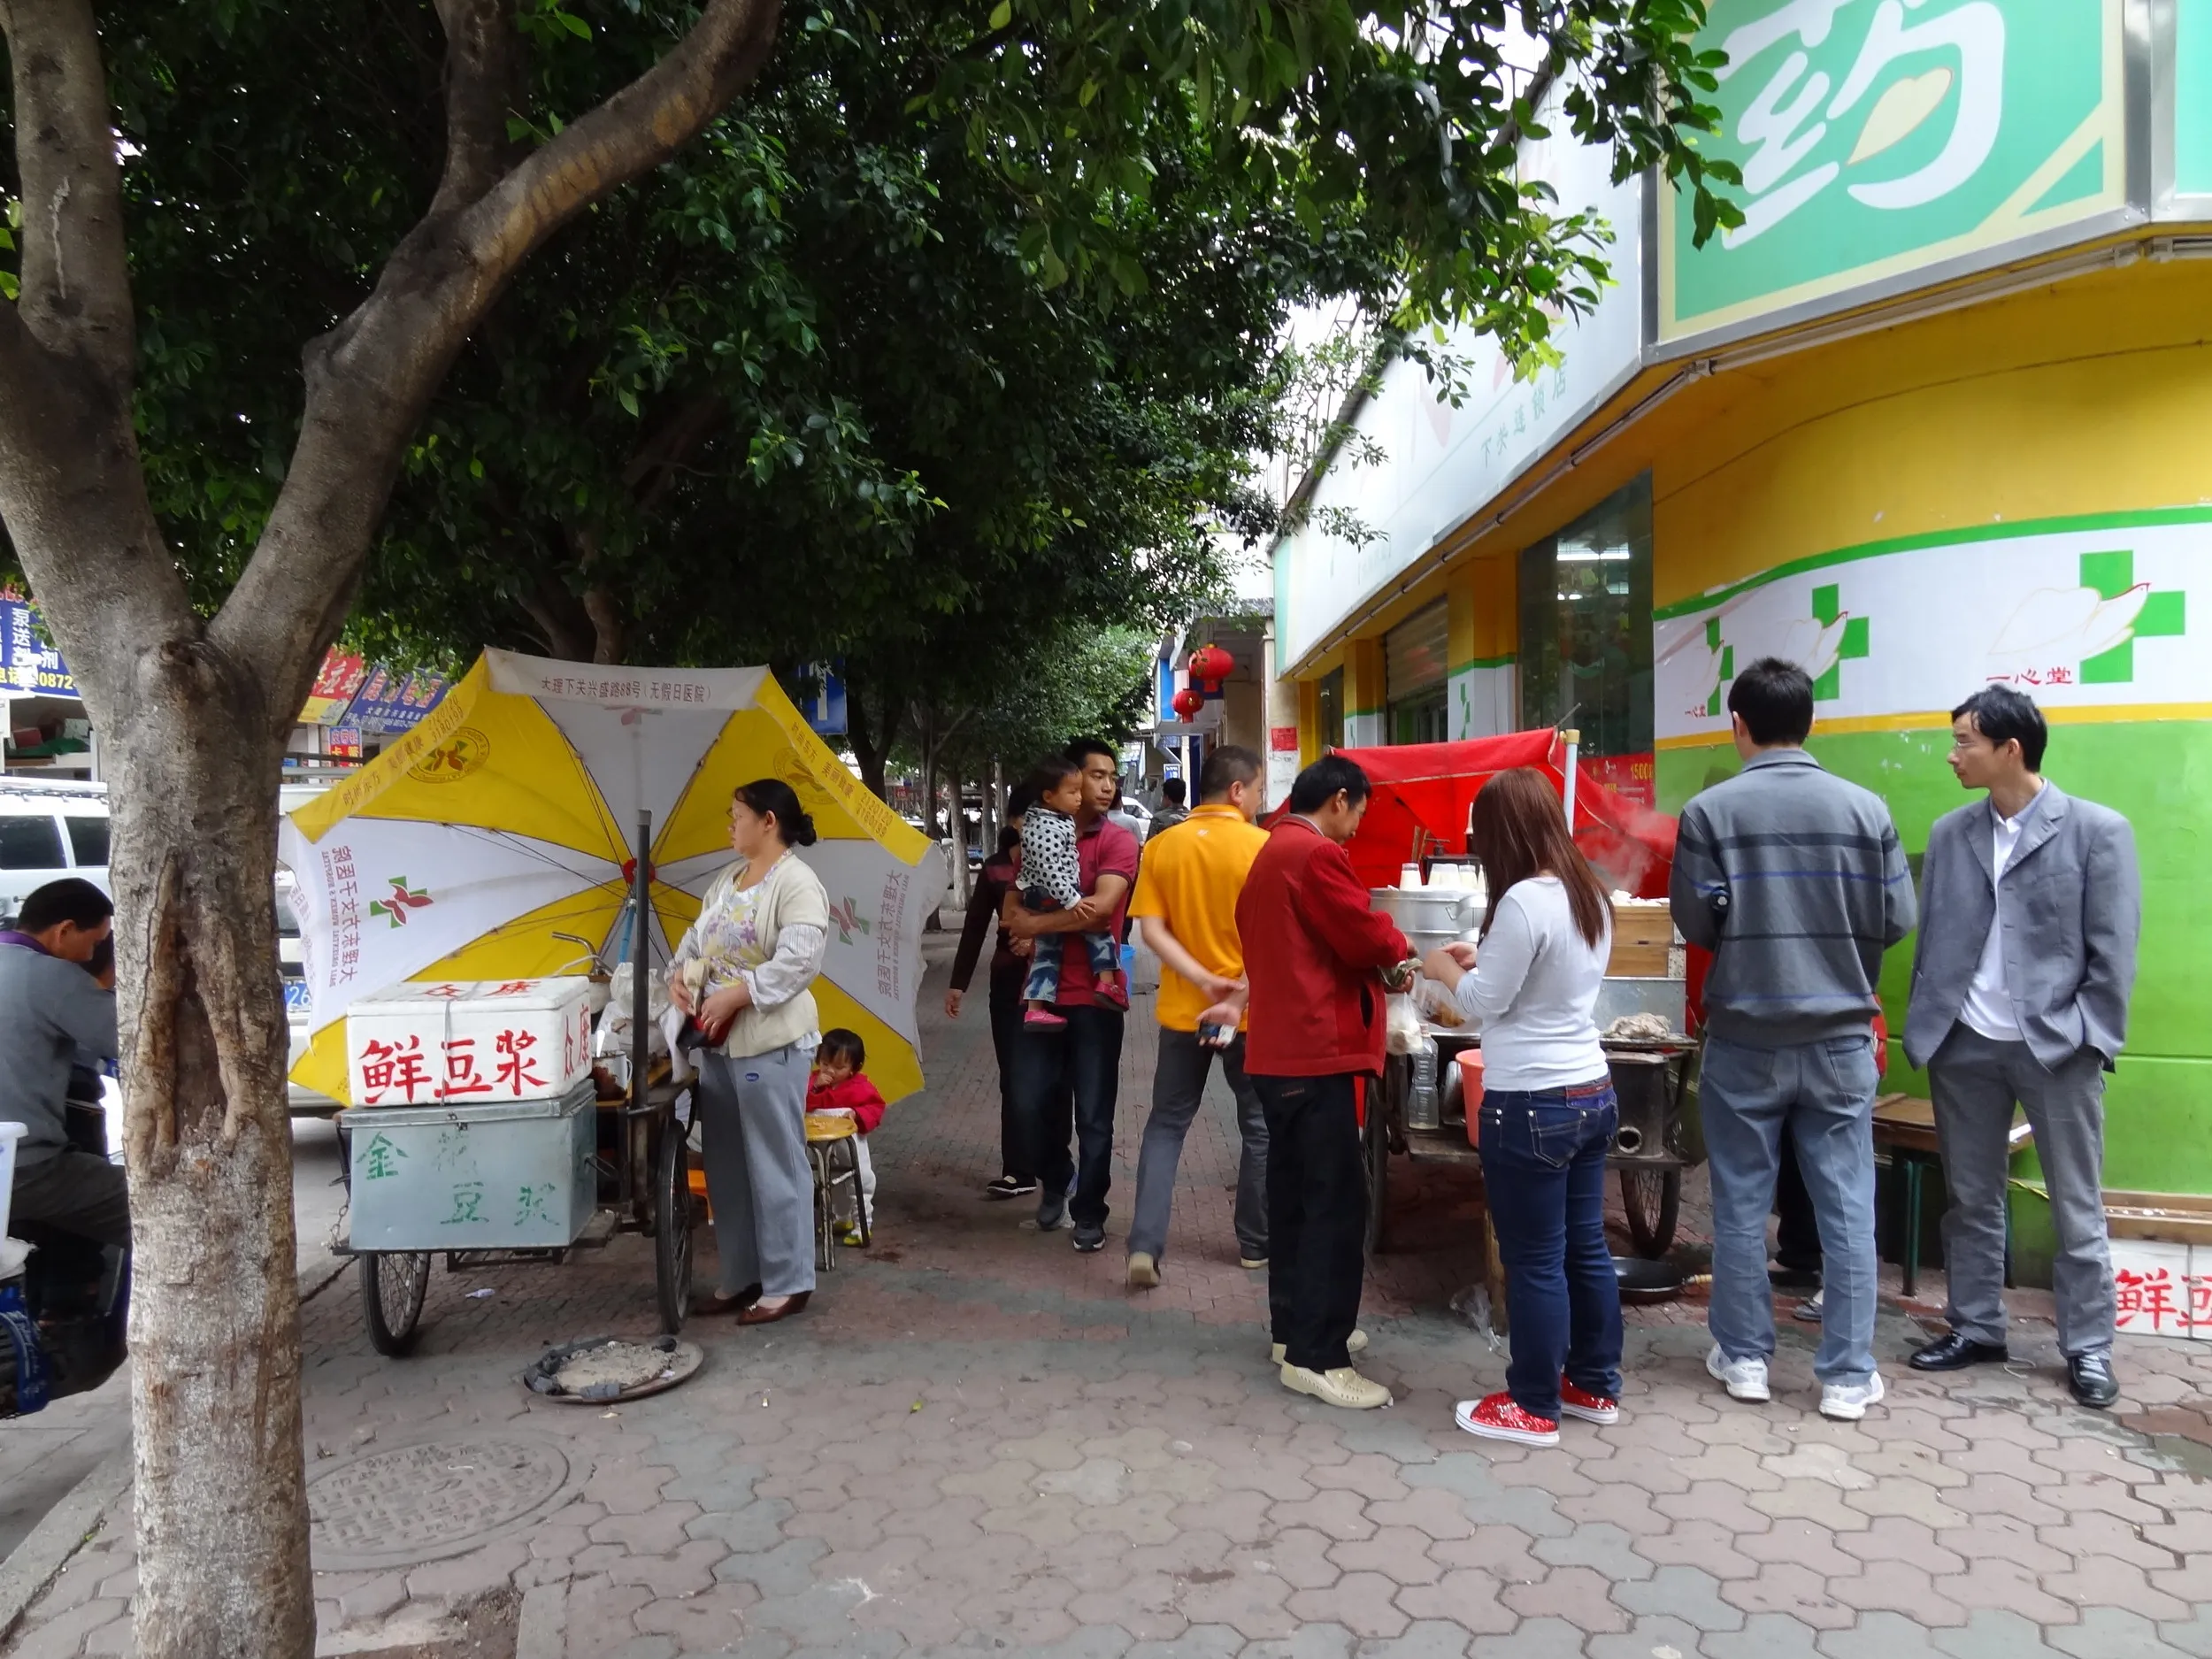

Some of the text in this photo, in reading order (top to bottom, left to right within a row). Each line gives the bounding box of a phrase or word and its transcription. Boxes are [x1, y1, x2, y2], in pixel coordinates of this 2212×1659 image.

[1715, 0, 2005, 250] 药
[1985, 666, 2073, 685] 一心堂
[358, 1030, 550, 1104] 鲜豆浆
[2115, 1267, 2212, 1332] 鲜豆
